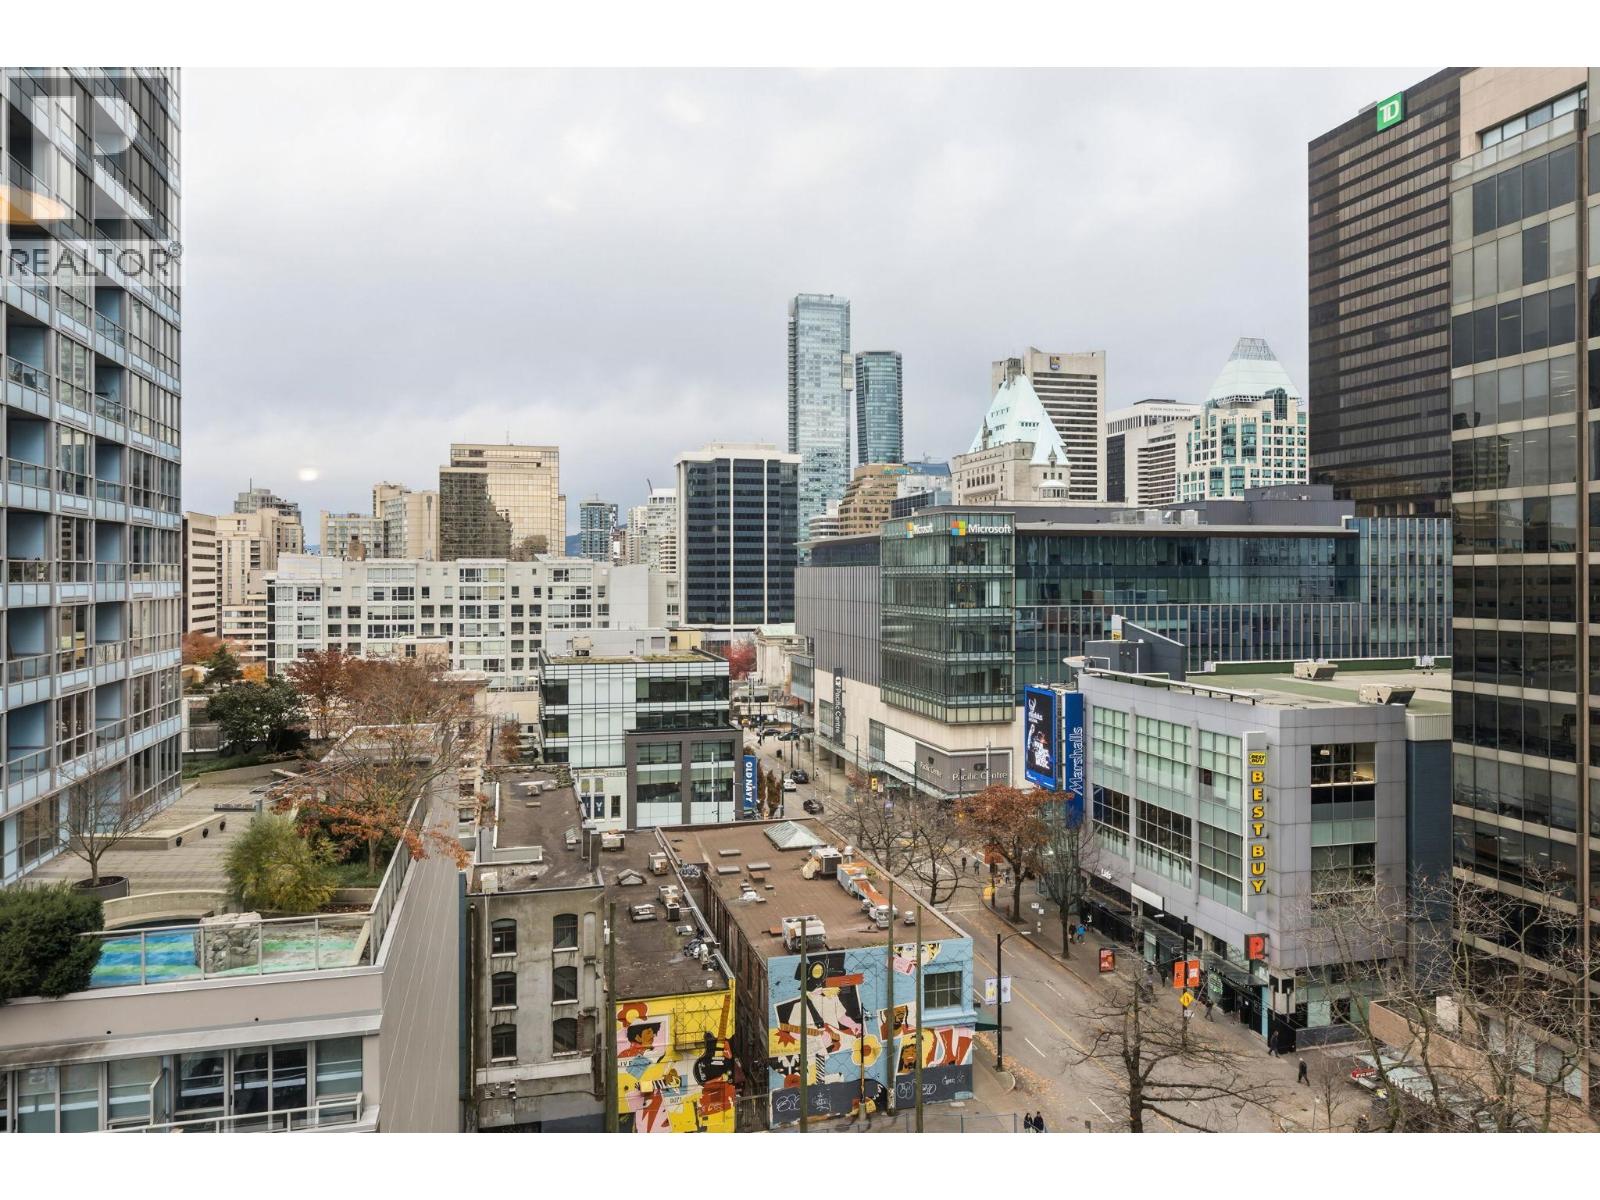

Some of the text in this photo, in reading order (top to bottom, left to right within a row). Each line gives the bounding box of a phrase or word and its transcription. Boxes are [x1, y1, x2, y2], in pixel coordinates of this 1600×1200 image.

[1379, 100, 1400, 123] TD
[968, 523, 1012, 534] Microsoft
[834, 688, 842, 710] Pacific
[834, 710, 842, 733] Centre
[1069, 726, 1083, 796] Marshalls
[745, 761, 753, 803] OLD NAVY
[980, 771, 1008, 780] Cntre
[1251, 769, 1265, 894] BEST BUY
